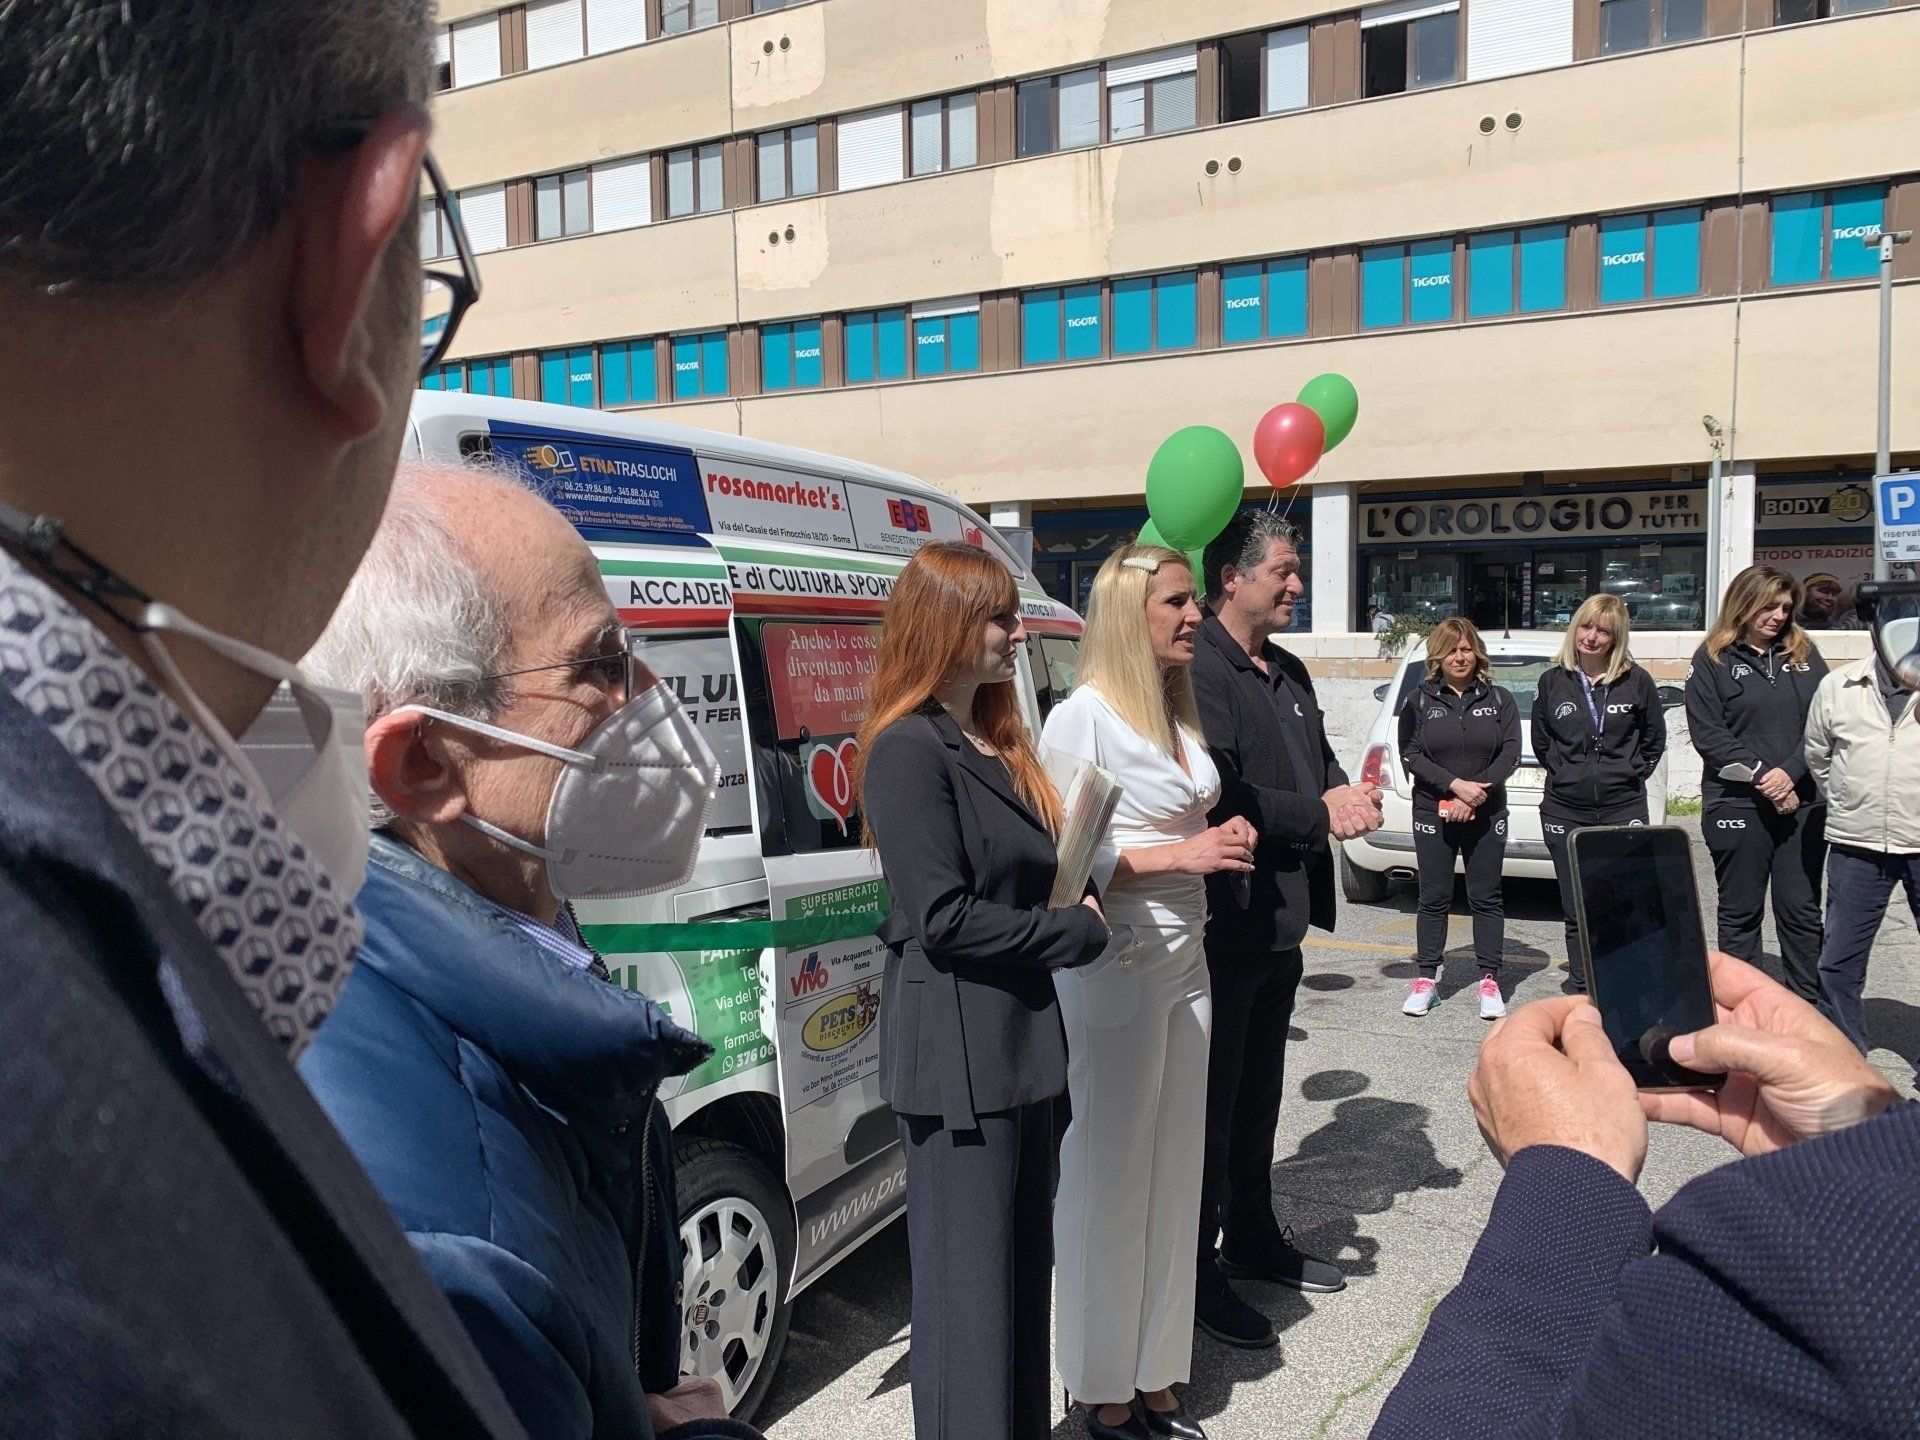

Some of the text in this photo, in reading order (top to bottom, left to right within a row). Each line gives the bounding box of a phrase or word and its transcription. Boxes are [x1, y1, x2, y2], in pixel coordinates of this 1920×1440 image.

[578, 456, 678, 482] ETNATRASLOCHI
[1763, 498, 1825, 515] BODY
[1889, 486, 1916, 521] P
[892, 499, 926, 533] EBS
[1366, 494, 1689, 538] L'OROLOGIO PER
[1639, 512, 1700, 529] TUTTI
[718, 520, 732, 531] Via
[732, 522, 744, 533] del
[745, 524, 768, 535] Casale
[769, 527, 780, 536] del
[780, 528, 811, 540] Finocchio
[833, 534, 851, 544] Roma
[746, 566, 765, 591] di
[769, 567, 846, 595] CULTURA
[788, 628, 832, 653] Anche
[833, 630, 847, 650] le
[850, 635, 877, 650] cose
[788, 656, 853, 679] diventano
[814, 682, 830, 703] da
[833, 682, 865, 704] mani
[800, 882, 879, 910] SUPERMERCATO
[830, 957, 841, 967] Via
[853, 960, 870, 972] Roma
[714, 995, 734, 1011] Via
[735, 988, 752, 1006] del
[819, 1004, 856, 1033] PETS
[819, 1022, 855, 1041] DISCOUNT
[736, 1047, 758, 1068] 376
